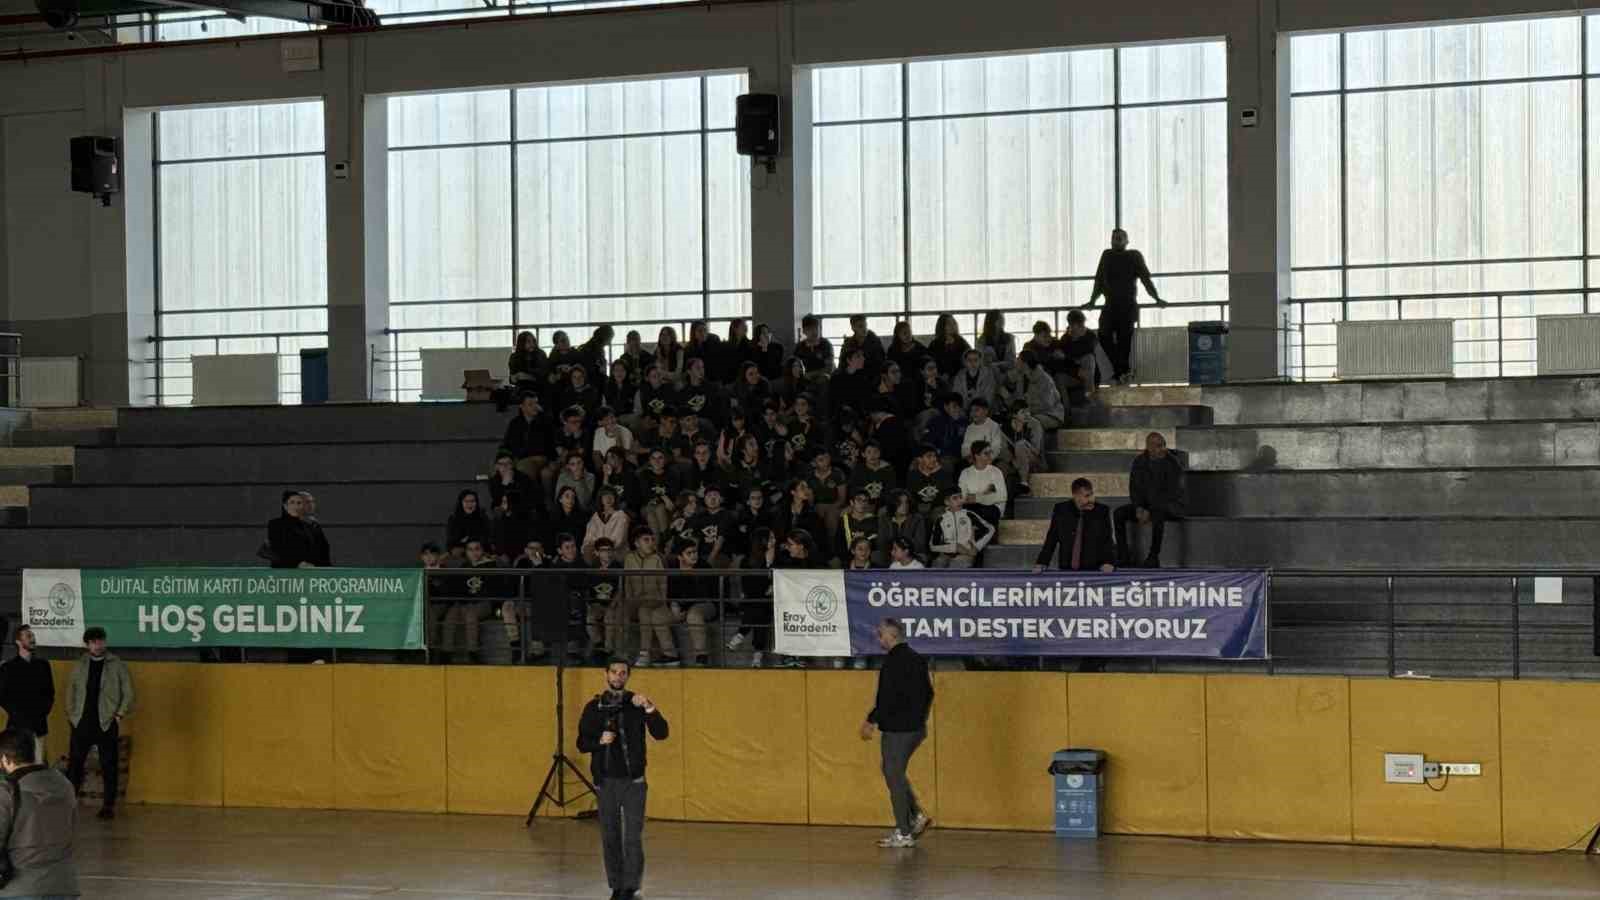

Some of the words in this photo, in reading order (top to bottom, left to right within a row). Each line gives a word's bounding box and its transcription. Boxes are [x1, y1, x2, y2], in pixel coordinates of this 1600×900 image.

[203, 578, 243, 593] KARTI
[247, 576, 305, 594] DAĞITIM
[309, 577, 404, 593] PROGRAMINA
[867, 582, 1104, 607] ÖĞRENCİLERİMİZİN
[1111, 581, 1243, 607] EĞİTİMİNE
[138, 604, 206, 642] HOŞ
[213, 597, 365, 633] GELDİNİZ
[783, 611, 806, 624] Eray
[783, 622, 838, 633] Karadeniz
[901, 618, 952, 638] TAM
[959, 618, 1055, 638] DESTEK
[1058, 613, 1207, 639] VERİYORUZ
